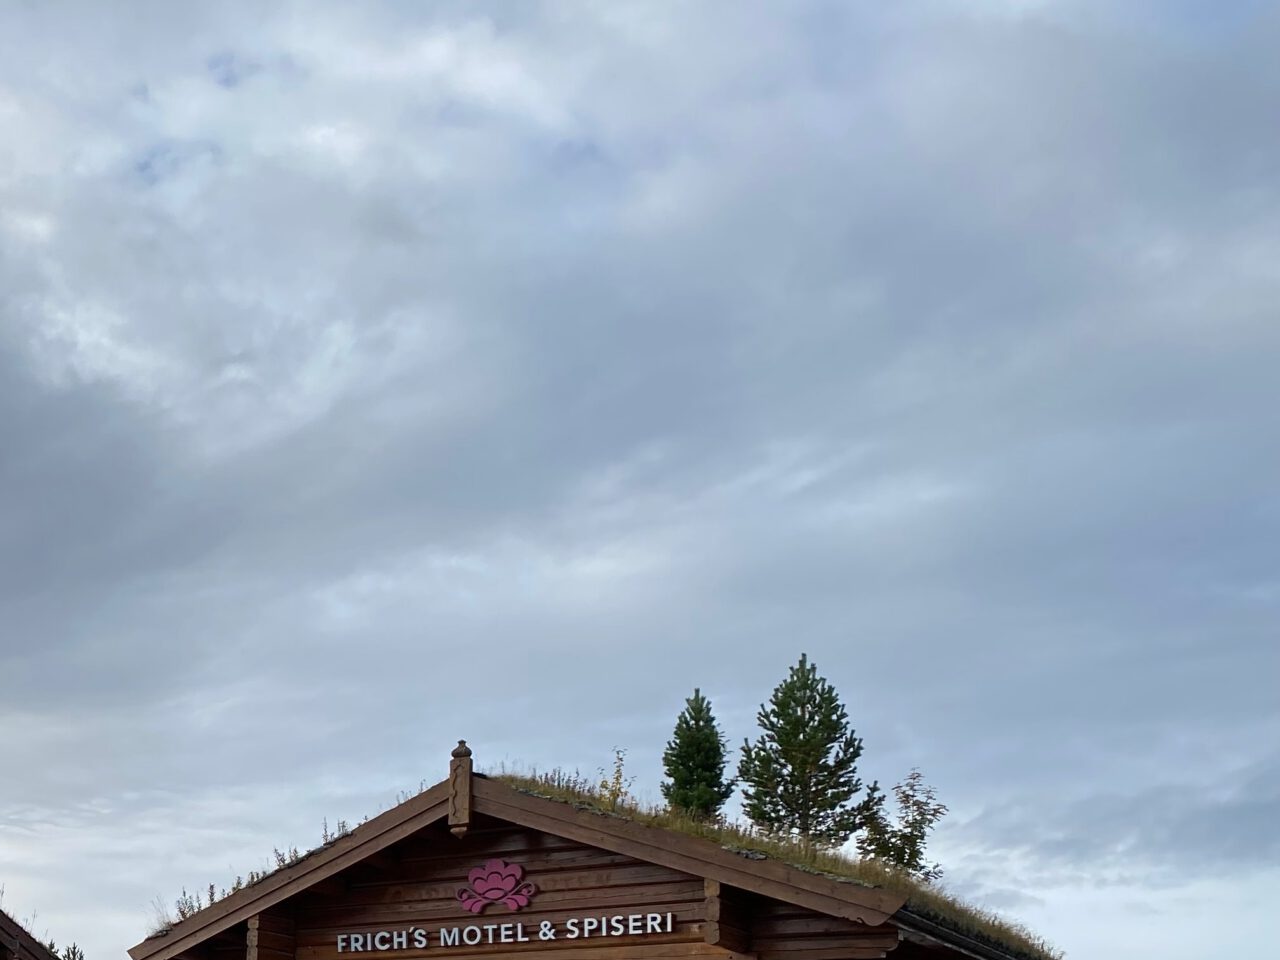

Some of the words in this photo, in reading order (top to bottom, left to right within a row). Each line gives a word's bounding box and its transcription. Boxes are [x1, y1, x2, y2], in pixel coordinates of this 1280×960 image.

[440, 922, 529, 947] MOTEL
[538, 920, 556, 940] &
[566, 912, 673, 939] SPISERI
